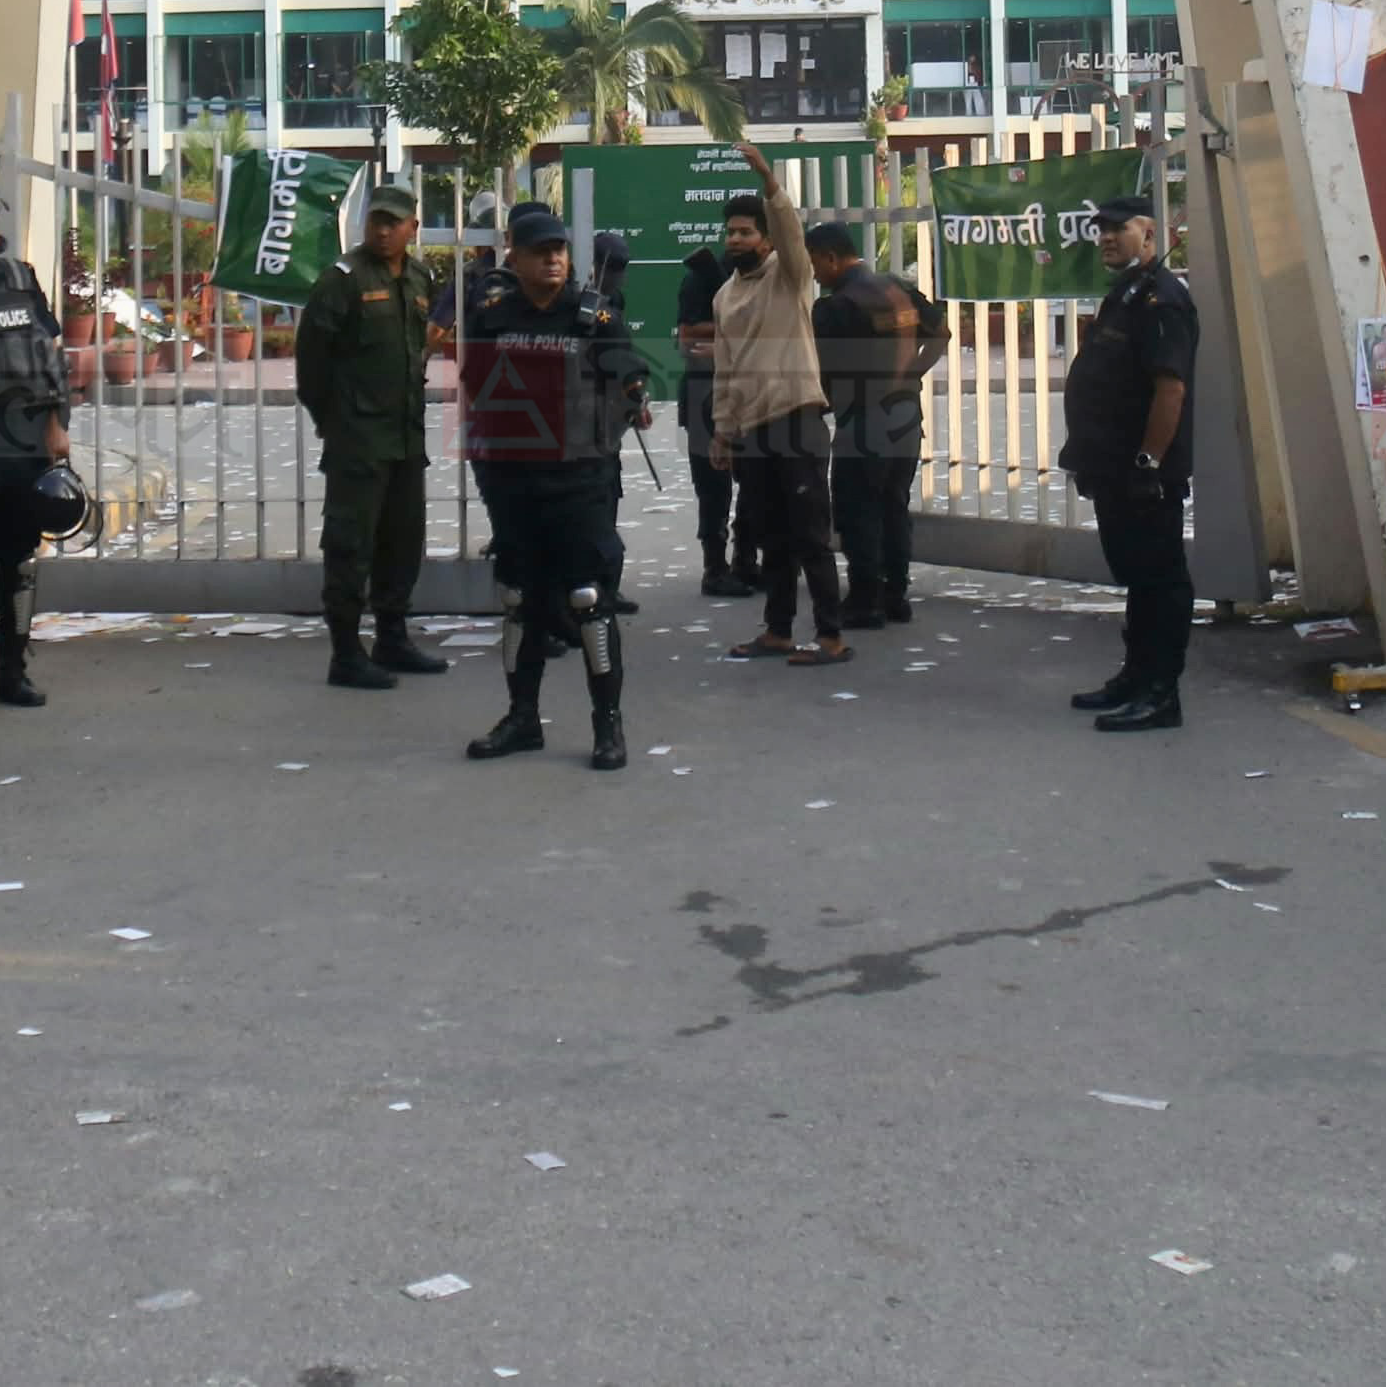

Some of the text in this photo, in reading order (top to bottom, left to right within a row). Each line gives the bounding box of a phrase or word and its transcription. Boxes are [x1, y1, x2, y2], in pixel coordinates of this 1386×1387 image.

[1065, 52, 1090, 69] WE
[1094, 52, 1139, 70] LOVE
[684, 189, 725, 202] मतदान
[941, 199, 1100, 250] बागमती प्रदे
[495, 333, 579, 353] NEPAL POLICE
